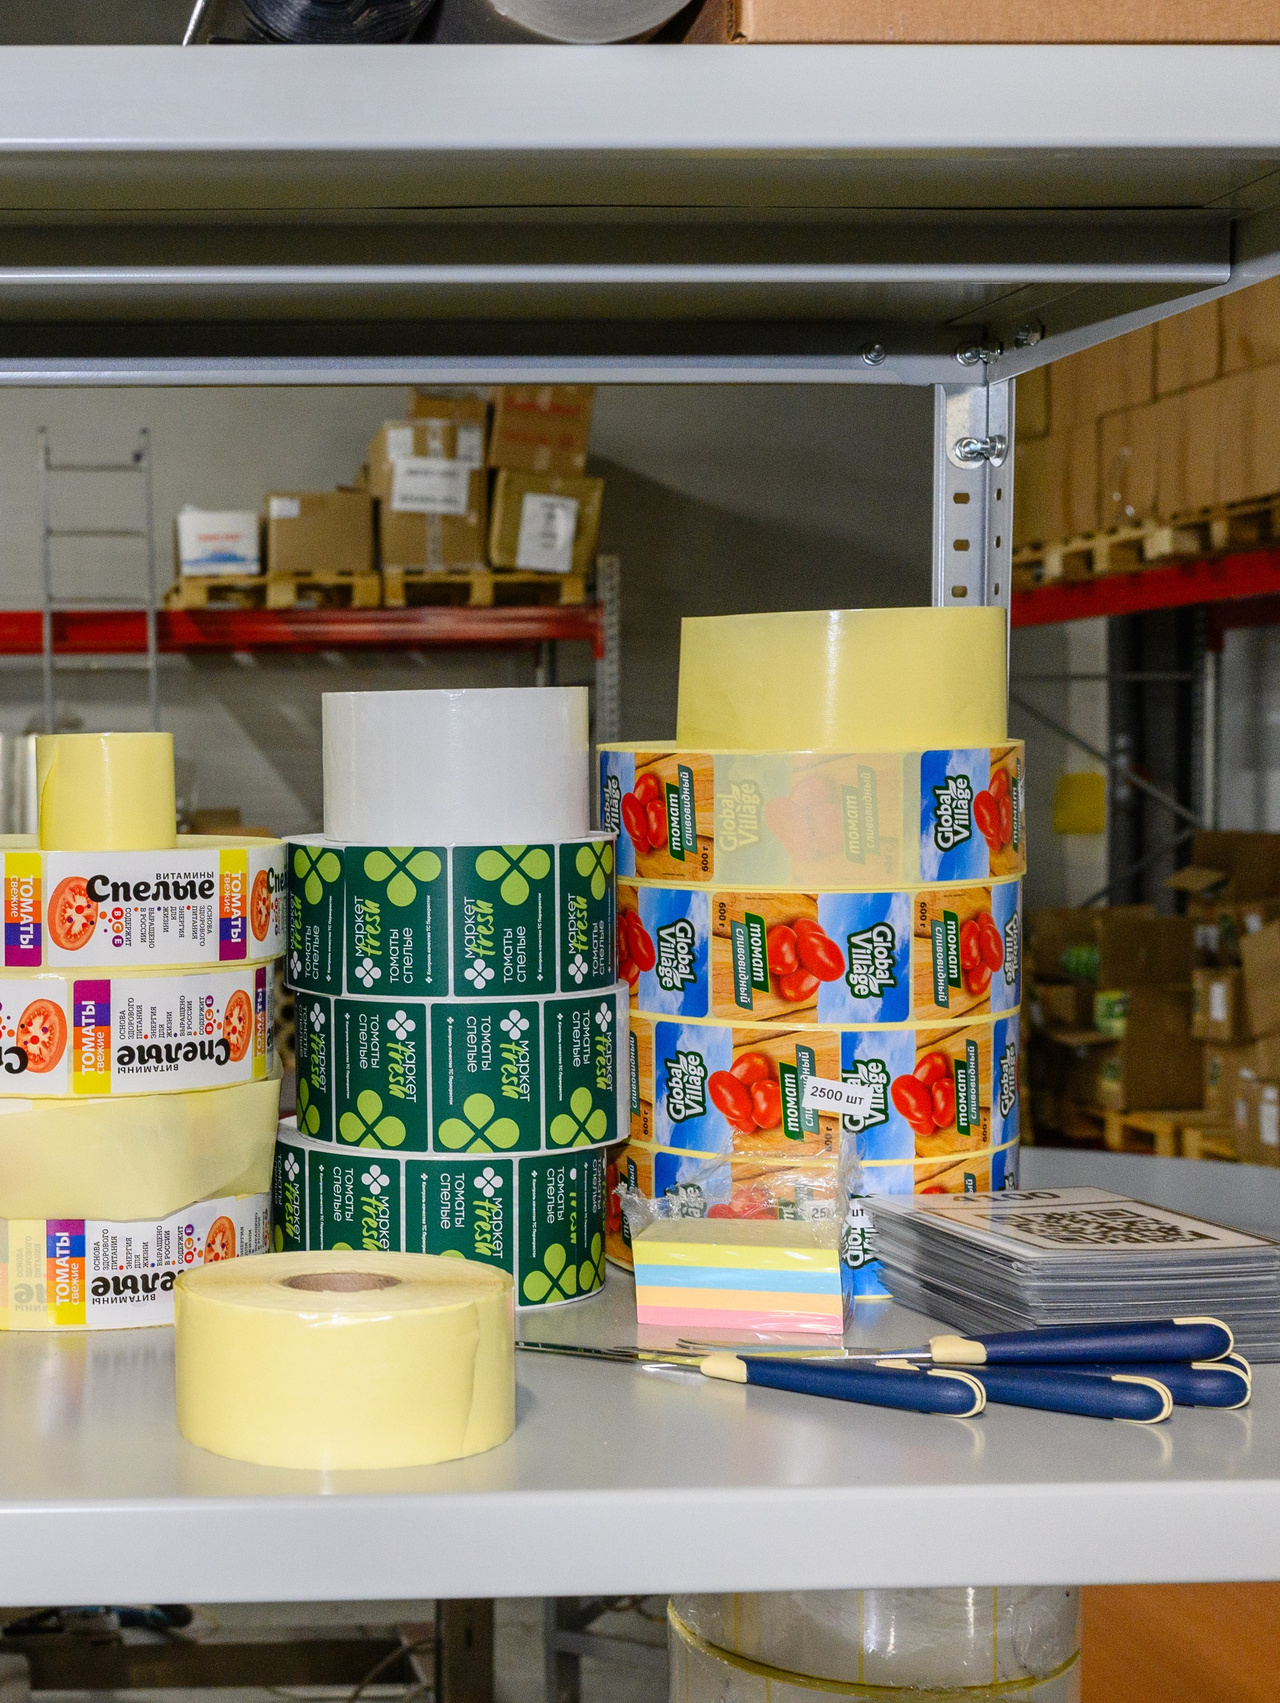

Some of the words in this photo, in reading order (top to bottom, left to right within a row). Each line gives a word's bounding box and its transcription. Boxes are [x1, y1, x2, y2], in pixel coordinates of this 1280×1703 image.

[670, 793, 681, 851] томат
[680, 771, 693, 846] сливовидный
[935, 789, 954, 848] Global
[953, 778, 971, 843] Village
[10, 874, 19, 919] свежие
[86, 874, 215, 903] Спелые
[156, 871, 214, 880] ВИТАМИНЫ
[20, 875, 35, 949] ТОМАТЫ
[230, 870, 242, 943] ТОМАТЫ
[354, 896, 365, 957] маркет
[464, 896, 478, 958] маркет
[718, 902, 726, 920] 600
[390, 929, 399, 983] томаты
[403, 927, 413, 984] спелые
[503, 928, 513, 983] томаты
[517, 926, 526, 982] спелые
[658, 926, 676, 988] Village
[675, 921, 695, 980] Global
[736, 928, 749, 1003] сливовидный
[750, 923, 765, 981] томат
[850, 931, 874, 995] Village
[872, 925, 895, 985] Global
[935, 926, 947, 1002] сливовидный
[947, 920, 958, 979] томат
[81, 1000, 95, 1075] ТОМАТЫ
[95, 1031, 104, 1075] свежие
[117, 1038, 230, 1066] Спелые
[359, 1013, 368, 1069] спелые
[370, 1014, 380, 1068] томаты
[466, 1016, 477, 1073] спелые
[481, 1016, 491, 1071] томаты
[118, 1063, 179, 1074] ВИТАМИНЫ
[402, 1041, 416, 1103] маркет
[517, 1040, 530, 1102] маркет
[667, 1062, 686, 1120] Global
[685, 1054, 705, 1116] Village
[810, 1086, 843, 1102] 2500
[846, 1095, 865, 1105] шт
[957, 1069, 968, 1126] томат
[968, 1046, 977, 1119] сливовидный
[784, 1073, 799, 1132] томат
[440, 1173, 450, 1229] спелые
[455, 1173, 465, 1228] томаты
[492, 1197, 503, 1259] маркет
[55, 1231, 70, 1306] ТОМАТЫ
[71, 1262, 80, 1305] свежие
[91, 1270, 184, 1297] елые
[92, 1293, 156, 1305] ВИТАМИНЫ
